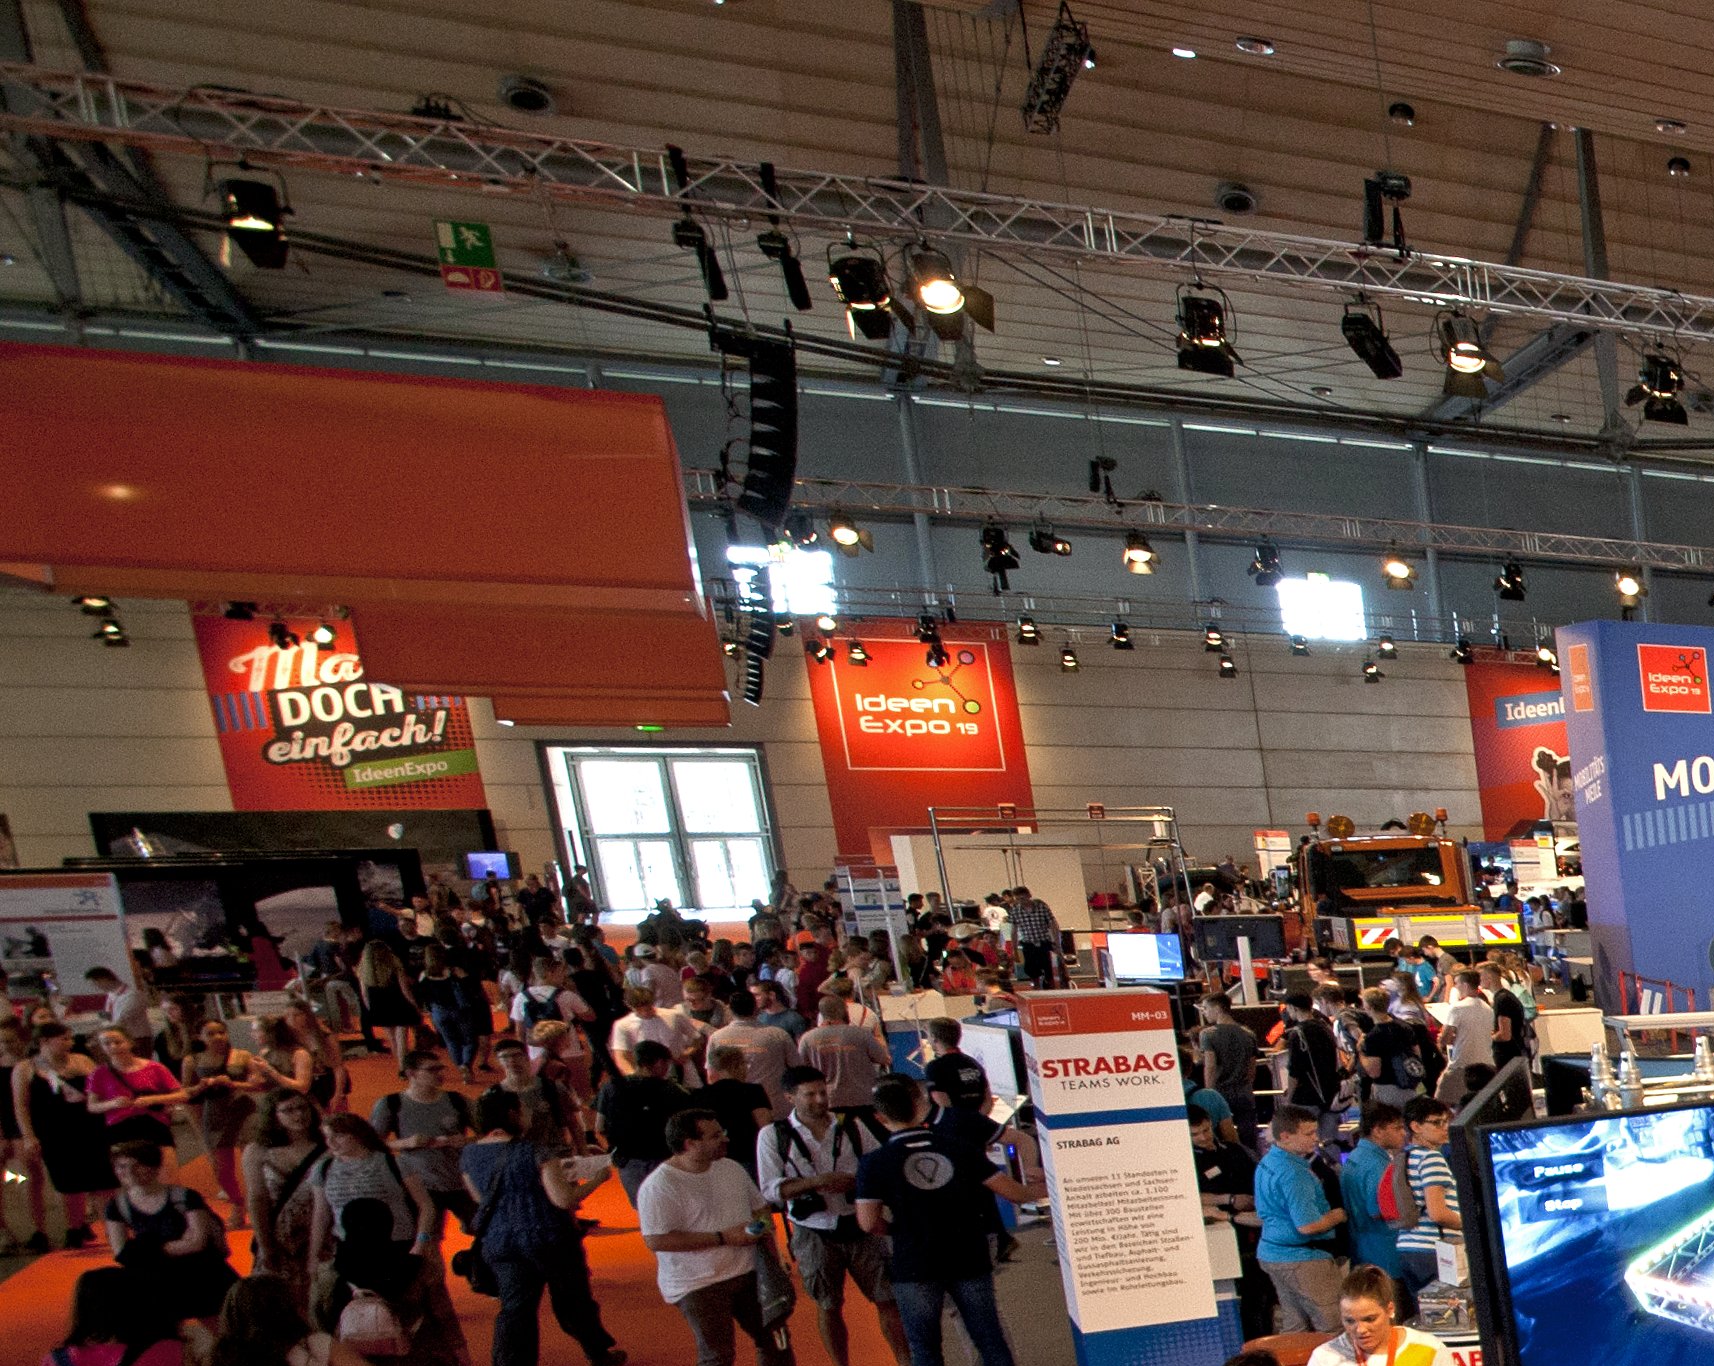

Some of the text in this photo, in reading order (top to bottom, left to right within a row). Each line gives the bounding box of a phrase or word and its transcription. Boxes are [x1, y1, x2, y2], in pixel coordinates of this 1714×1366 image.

[1648, 672, 1692, 684] Ideen
[1649, 684, 1689, 695] Expo
[276, 683, 405, 727] DOCH
[855, 693, 956, 714] Ideen
[859, 715, 979, 736] Expo 19
[267, 711, 447, 767] einfach!
[353, 759, 448, 784] IdeenExpo
[1131, 1011, 1168, 1021] MM-03
[1041, 1052, 1175, 1079] STRABAG
[1060, 1075, 1165, 1091] TEAMS WORK.
[1056, 1136, 1120, 1150] STRABAG AG
[1533, 1162, 1584, 1178] Pause
[1544, 1198, 1583, 1212] Stop
